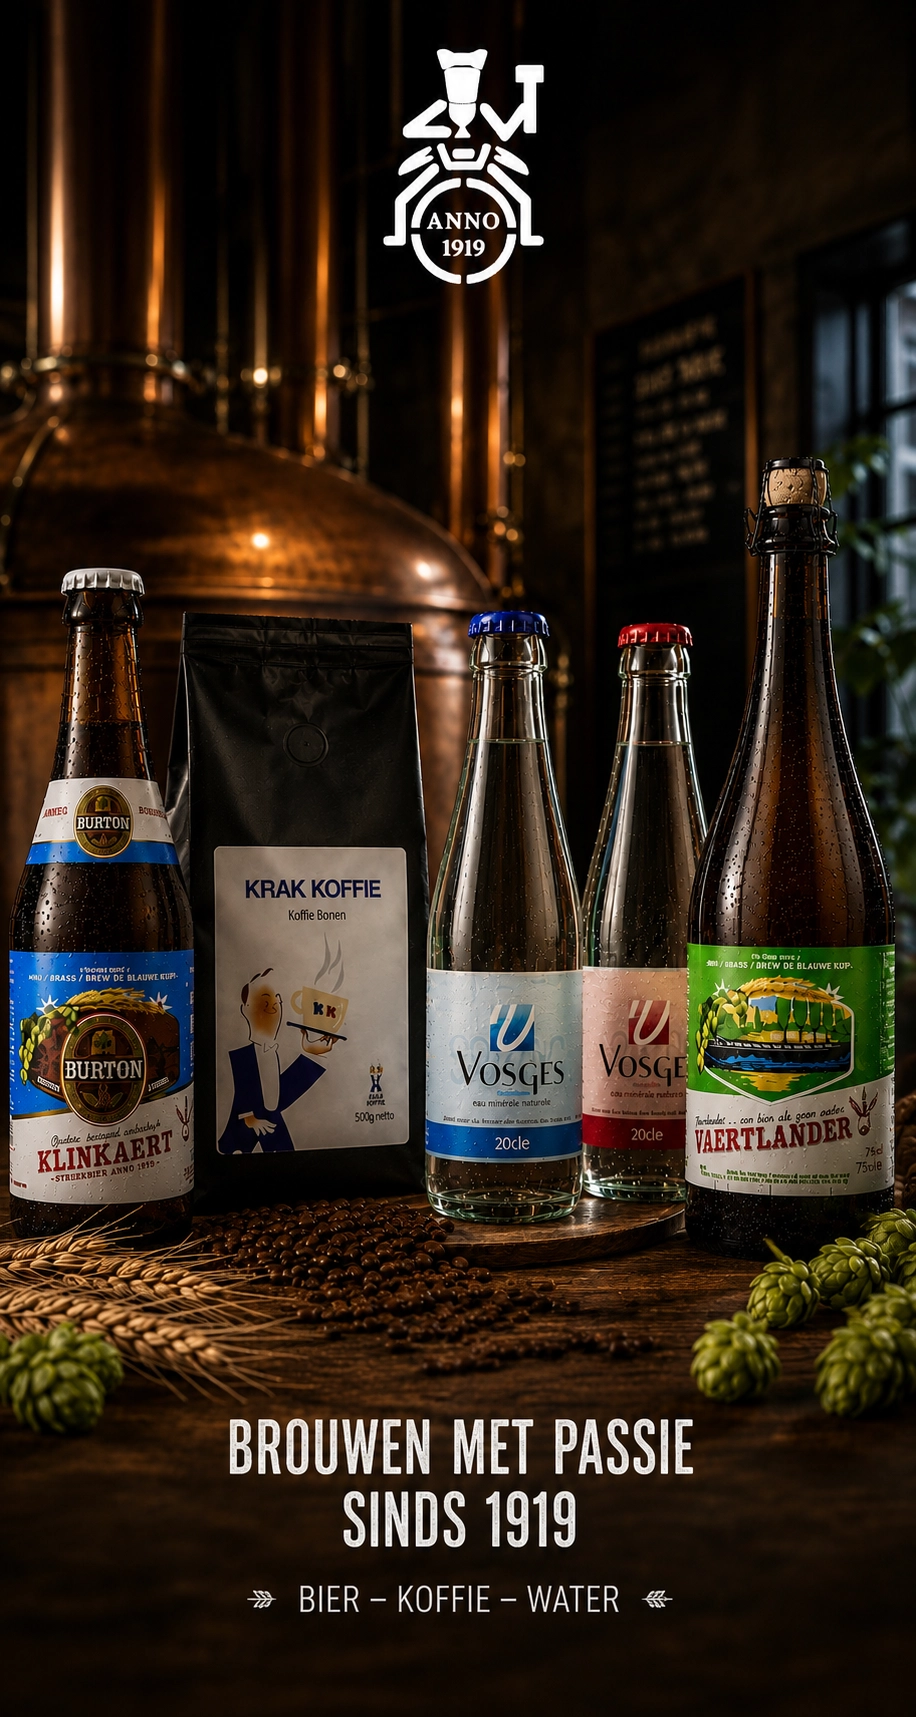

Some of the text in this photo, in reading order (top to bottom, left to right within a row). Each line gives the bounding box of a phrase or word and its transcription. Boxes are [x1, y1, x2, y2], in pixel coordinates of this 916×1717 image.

[76, 816, 131, 830] BURTON
[245, 879, 382, 899] KRAK KOFFIE
[288, 909, 347, 921] Koffie Bonen
[783, 961, 794, 970] DE
[796, 961, 832, 970] BLAUWE
[113, 974, 124, 982] DE
[65, 1060, 143, 1080] BURTON
[456, 1050, 565, 1094] VOSGES
[354, 1111, 395, 1124] 500g netto
[631, 1127, 664, 1142] 20cle
[695, 1116, 853, 1154] VAERTLANDER
[494, 1135, 530, 1151] 20cle
[37, 1130, 173, 1174] KLINKAERT
[111, 1166, 135, 1177] ANNO
